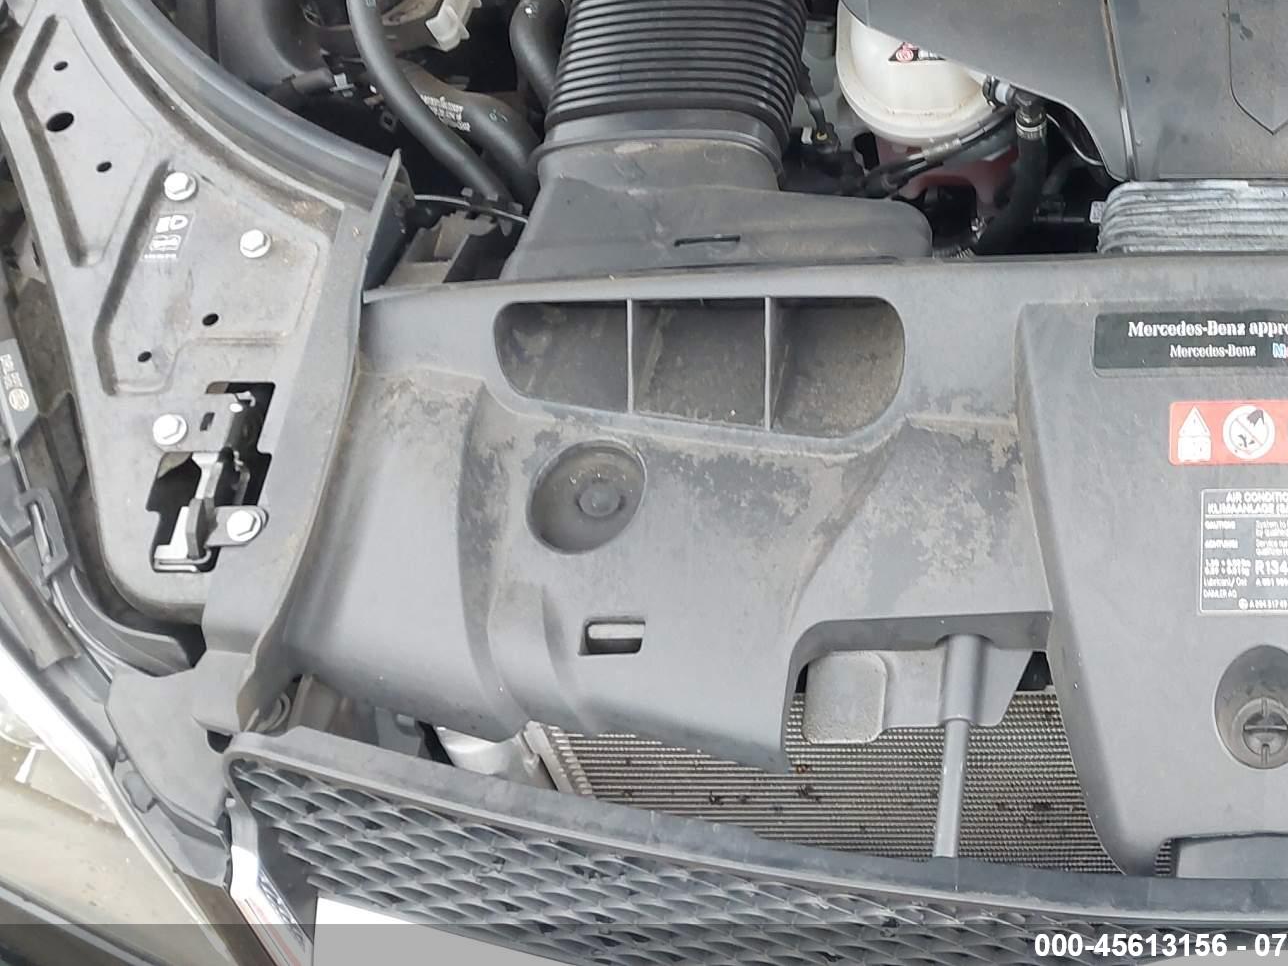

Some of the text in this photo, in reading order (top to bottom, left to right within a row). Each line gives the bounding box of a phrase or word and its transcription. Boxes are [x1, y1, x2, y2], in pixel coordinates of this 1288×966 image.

[1128, 320, 1246, 337] Mercedes-Benz
[1170, 343, 1256, 359] Mercedes-Benz
[1226, 491, 1242, 503] AIR
[1207, 503, 1275, 514] KLIMAANLAGE
